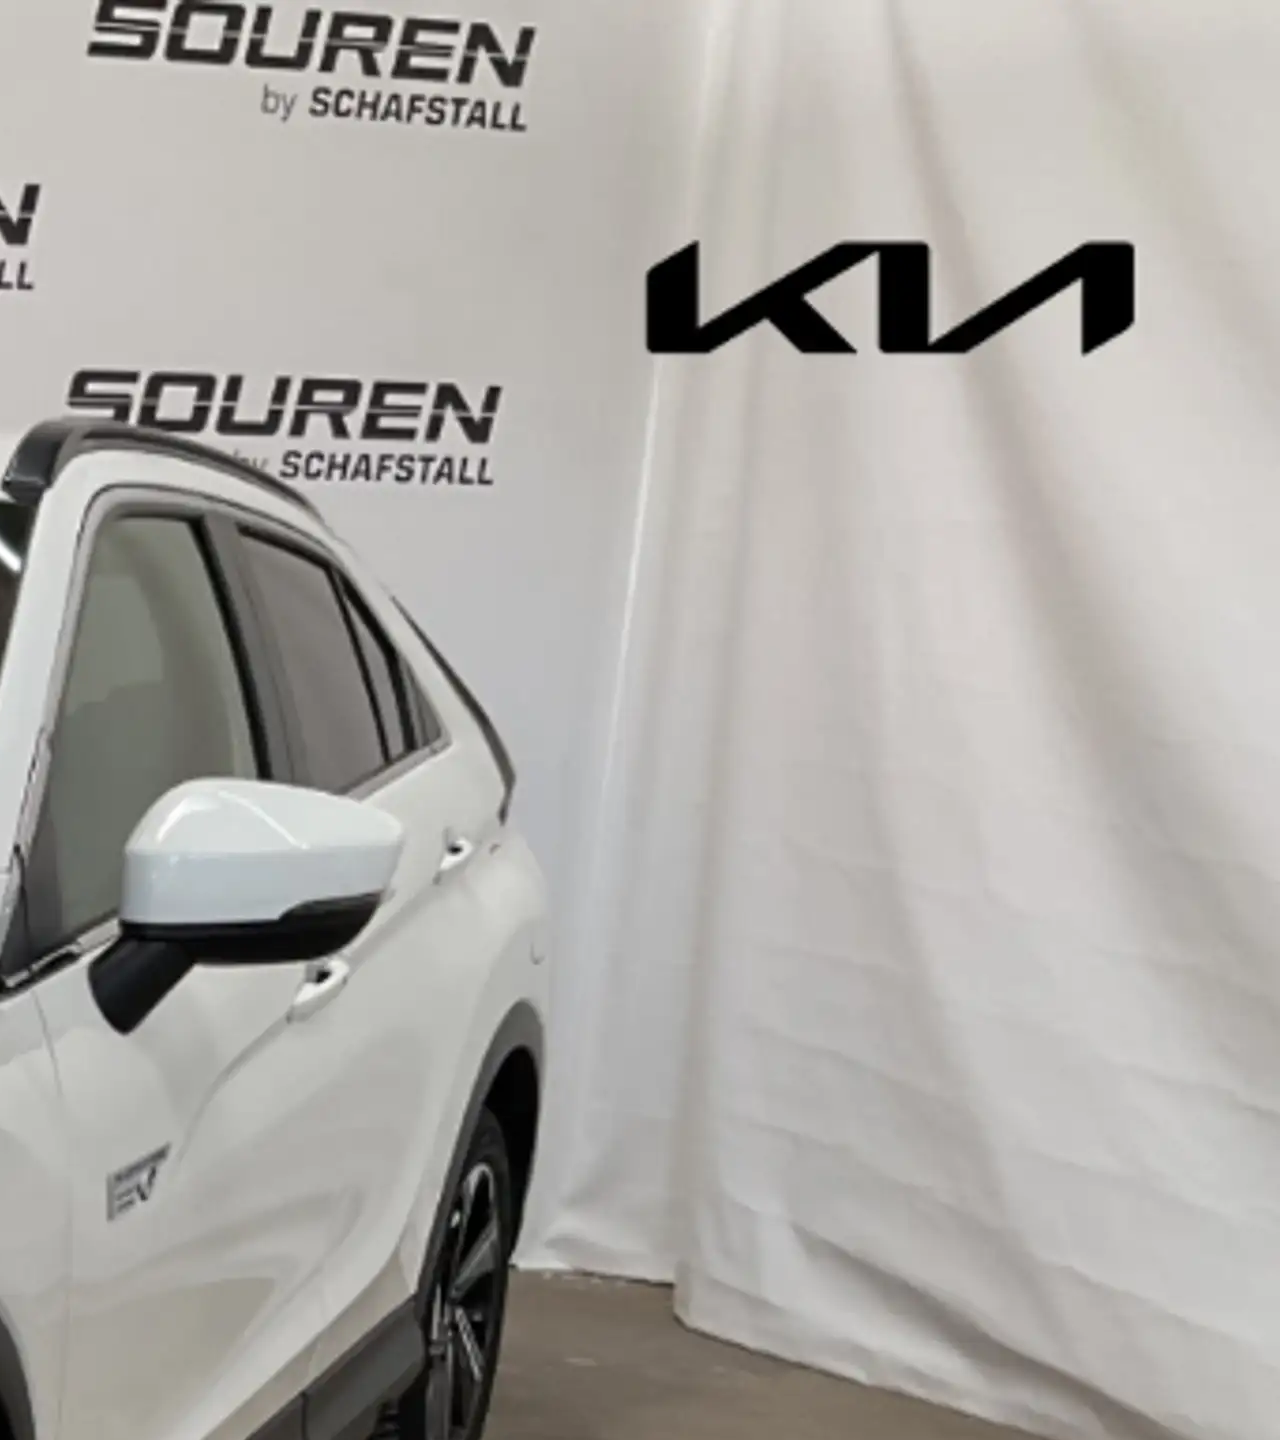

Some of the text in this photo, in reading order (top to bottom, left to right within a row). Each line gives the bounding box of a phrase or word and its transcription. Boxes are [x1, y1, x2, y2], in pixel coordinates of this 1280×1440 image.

[87, 0, 535, 88] SOUREN
[260, 84, 527, 132] by SCHAFSTALL
[67, 370, 502, 444] SOUREN
[279, 450, 494, 486] SCHAFSTALL
